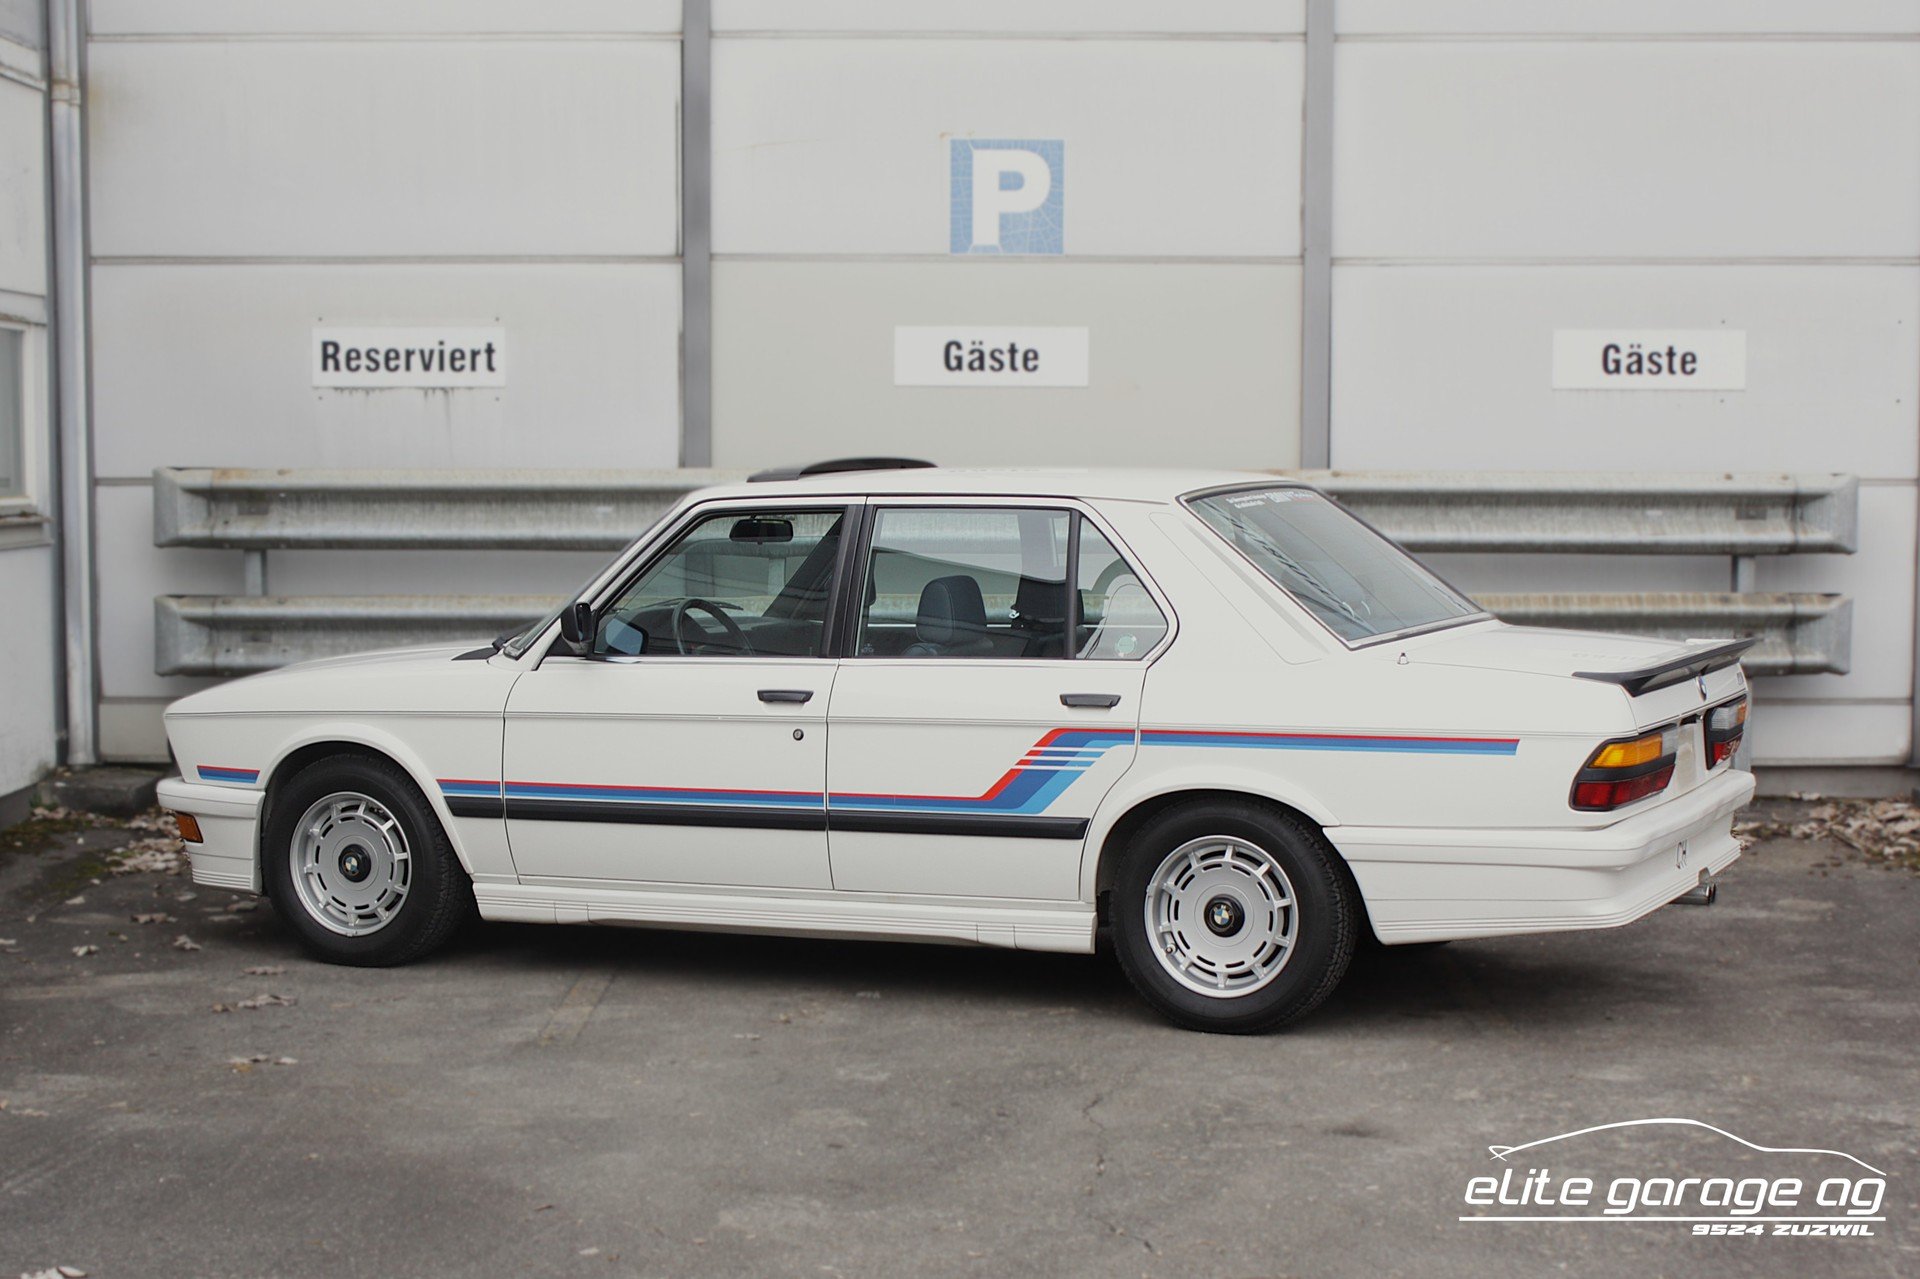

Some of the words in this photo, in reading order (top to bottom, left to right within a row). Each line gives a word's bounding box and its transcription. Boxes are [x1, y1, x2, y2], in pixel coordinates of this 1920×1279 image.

[971, 148, 1051, 247] P
[321, 340, 496, 373] Reserviert
[943, 340, 1039, 373] Gäste
[1601, 343, 1697, 376] Gäste
